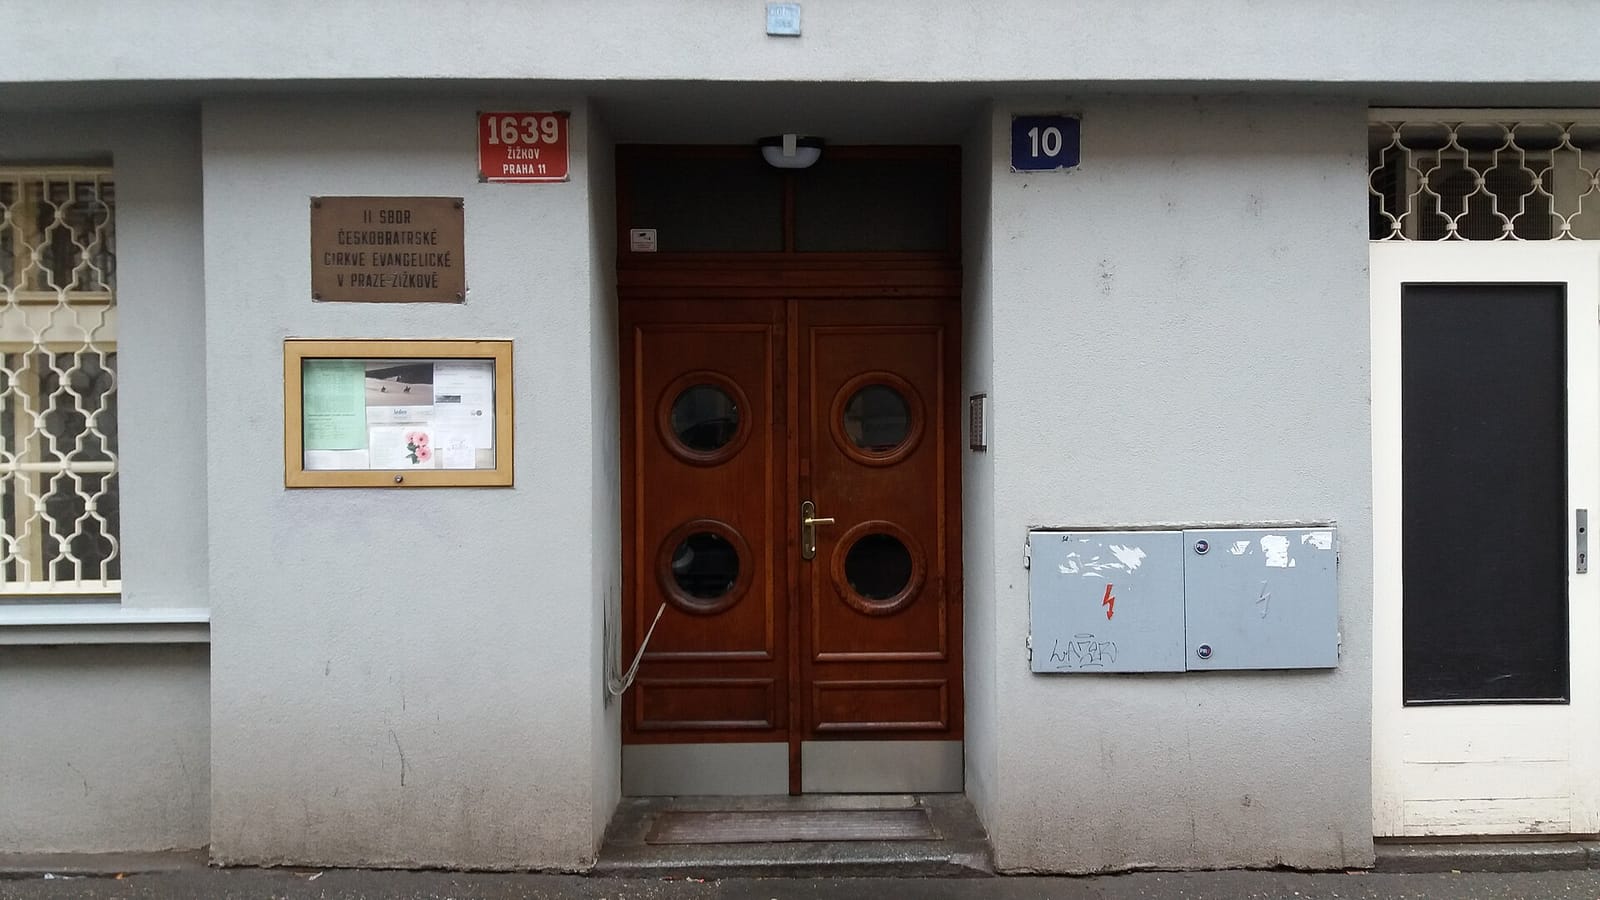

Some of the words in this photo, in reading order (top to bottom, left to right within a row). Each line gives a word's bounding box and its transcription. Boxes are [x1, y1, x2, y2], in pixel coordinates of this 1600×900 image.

[488, 116, 559, 144] 1639
[1028, 126, 1062, 157] 10
[507, 146, 540, 160] ŽIŽKOV
[503, 164, 535, 174] PRAHA
[538, 164, 546, 174] 11
[363, 210, 372, 224] II
[379, 209, 411, 224] SBOR
[338, 228, 438, 245] ČESKOBRATRSKÉ
[372, 250, 451, 268] EVANGELICKÉ
[337, 273, 344, 287] V
